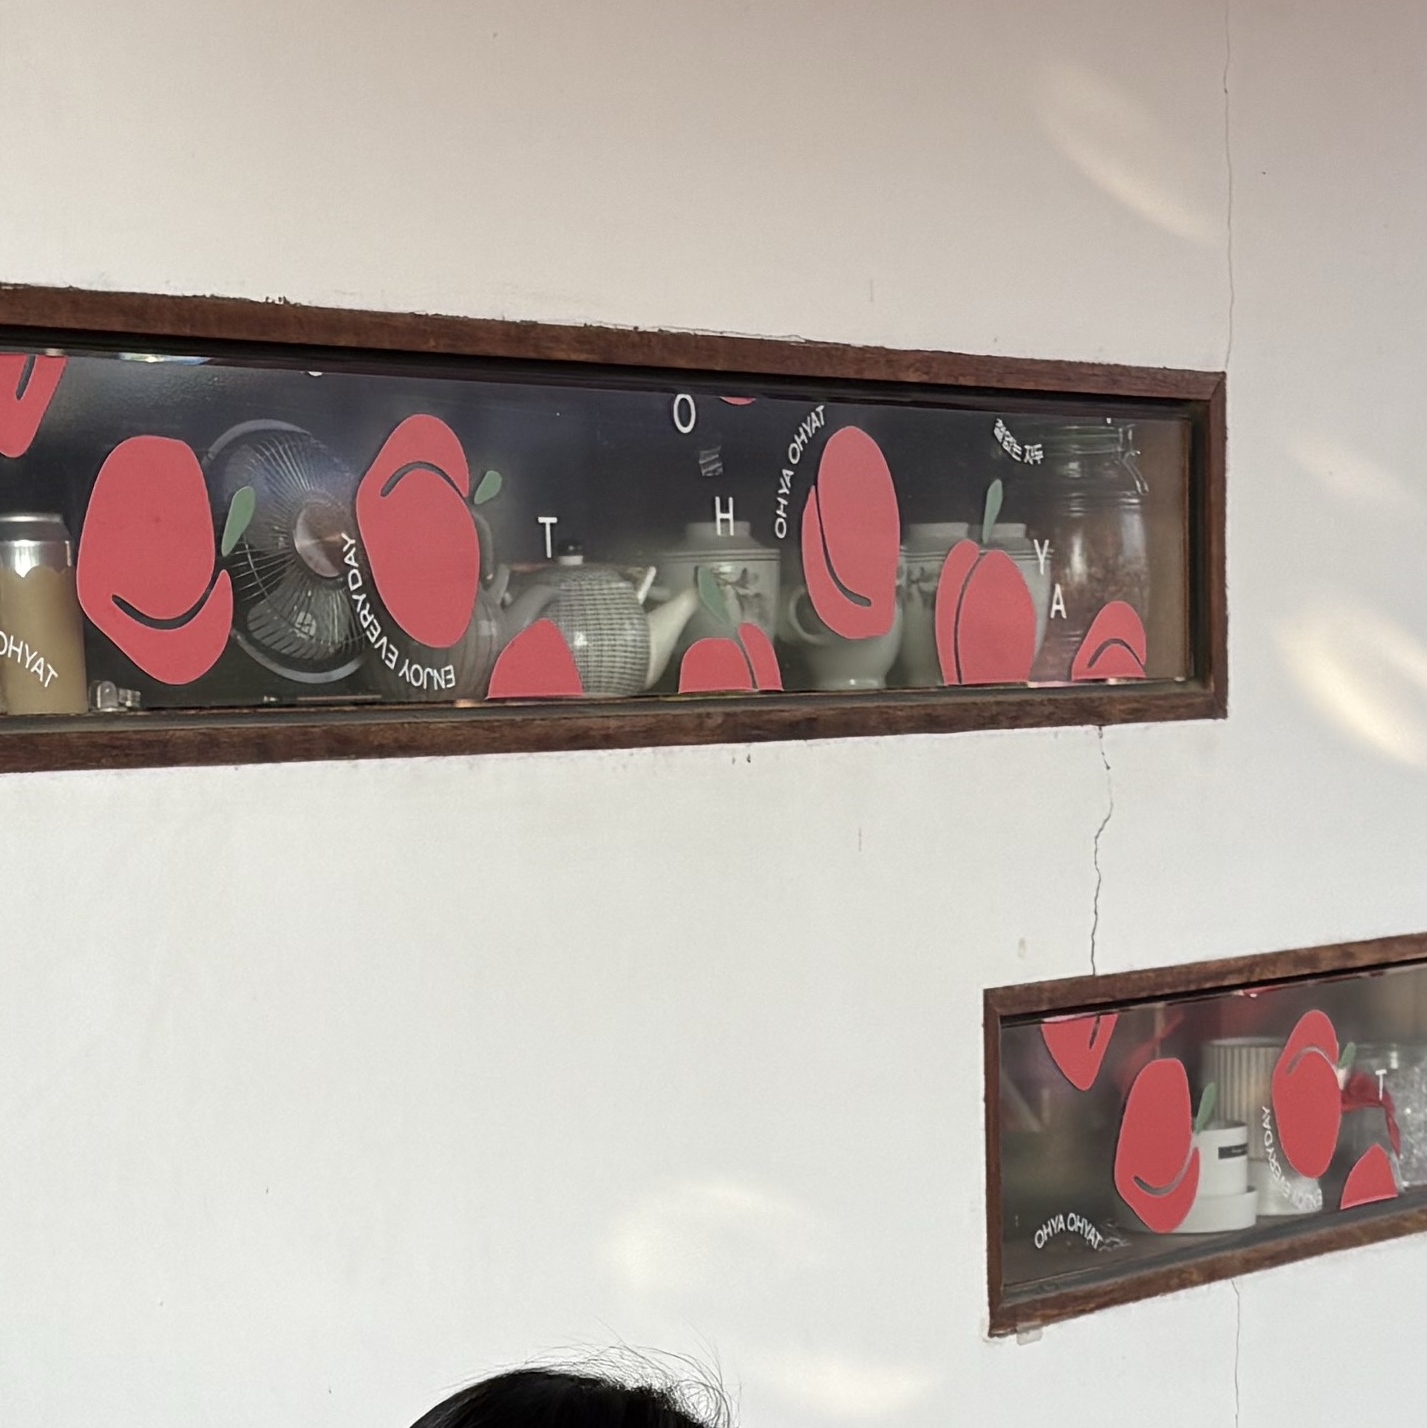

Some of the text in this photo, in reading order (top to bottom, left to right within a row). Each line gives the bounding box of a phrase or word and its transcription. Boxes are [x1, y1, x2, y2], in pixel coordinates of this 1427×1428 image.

[775, 405, 824, 538] OHYA OHYAT
[715, 496, 734, 536] H
[538, 516, 558, 558] T
[1033, 539, 1049, 575] Y
[341, 532, 456, 690] ENJOY EVERYDAY
[1050, 583, 1067, 619] A
[1375, 1069, 1387, 1100] T
[1034, 1212, 1104, 1250] OHYA OHYAT
